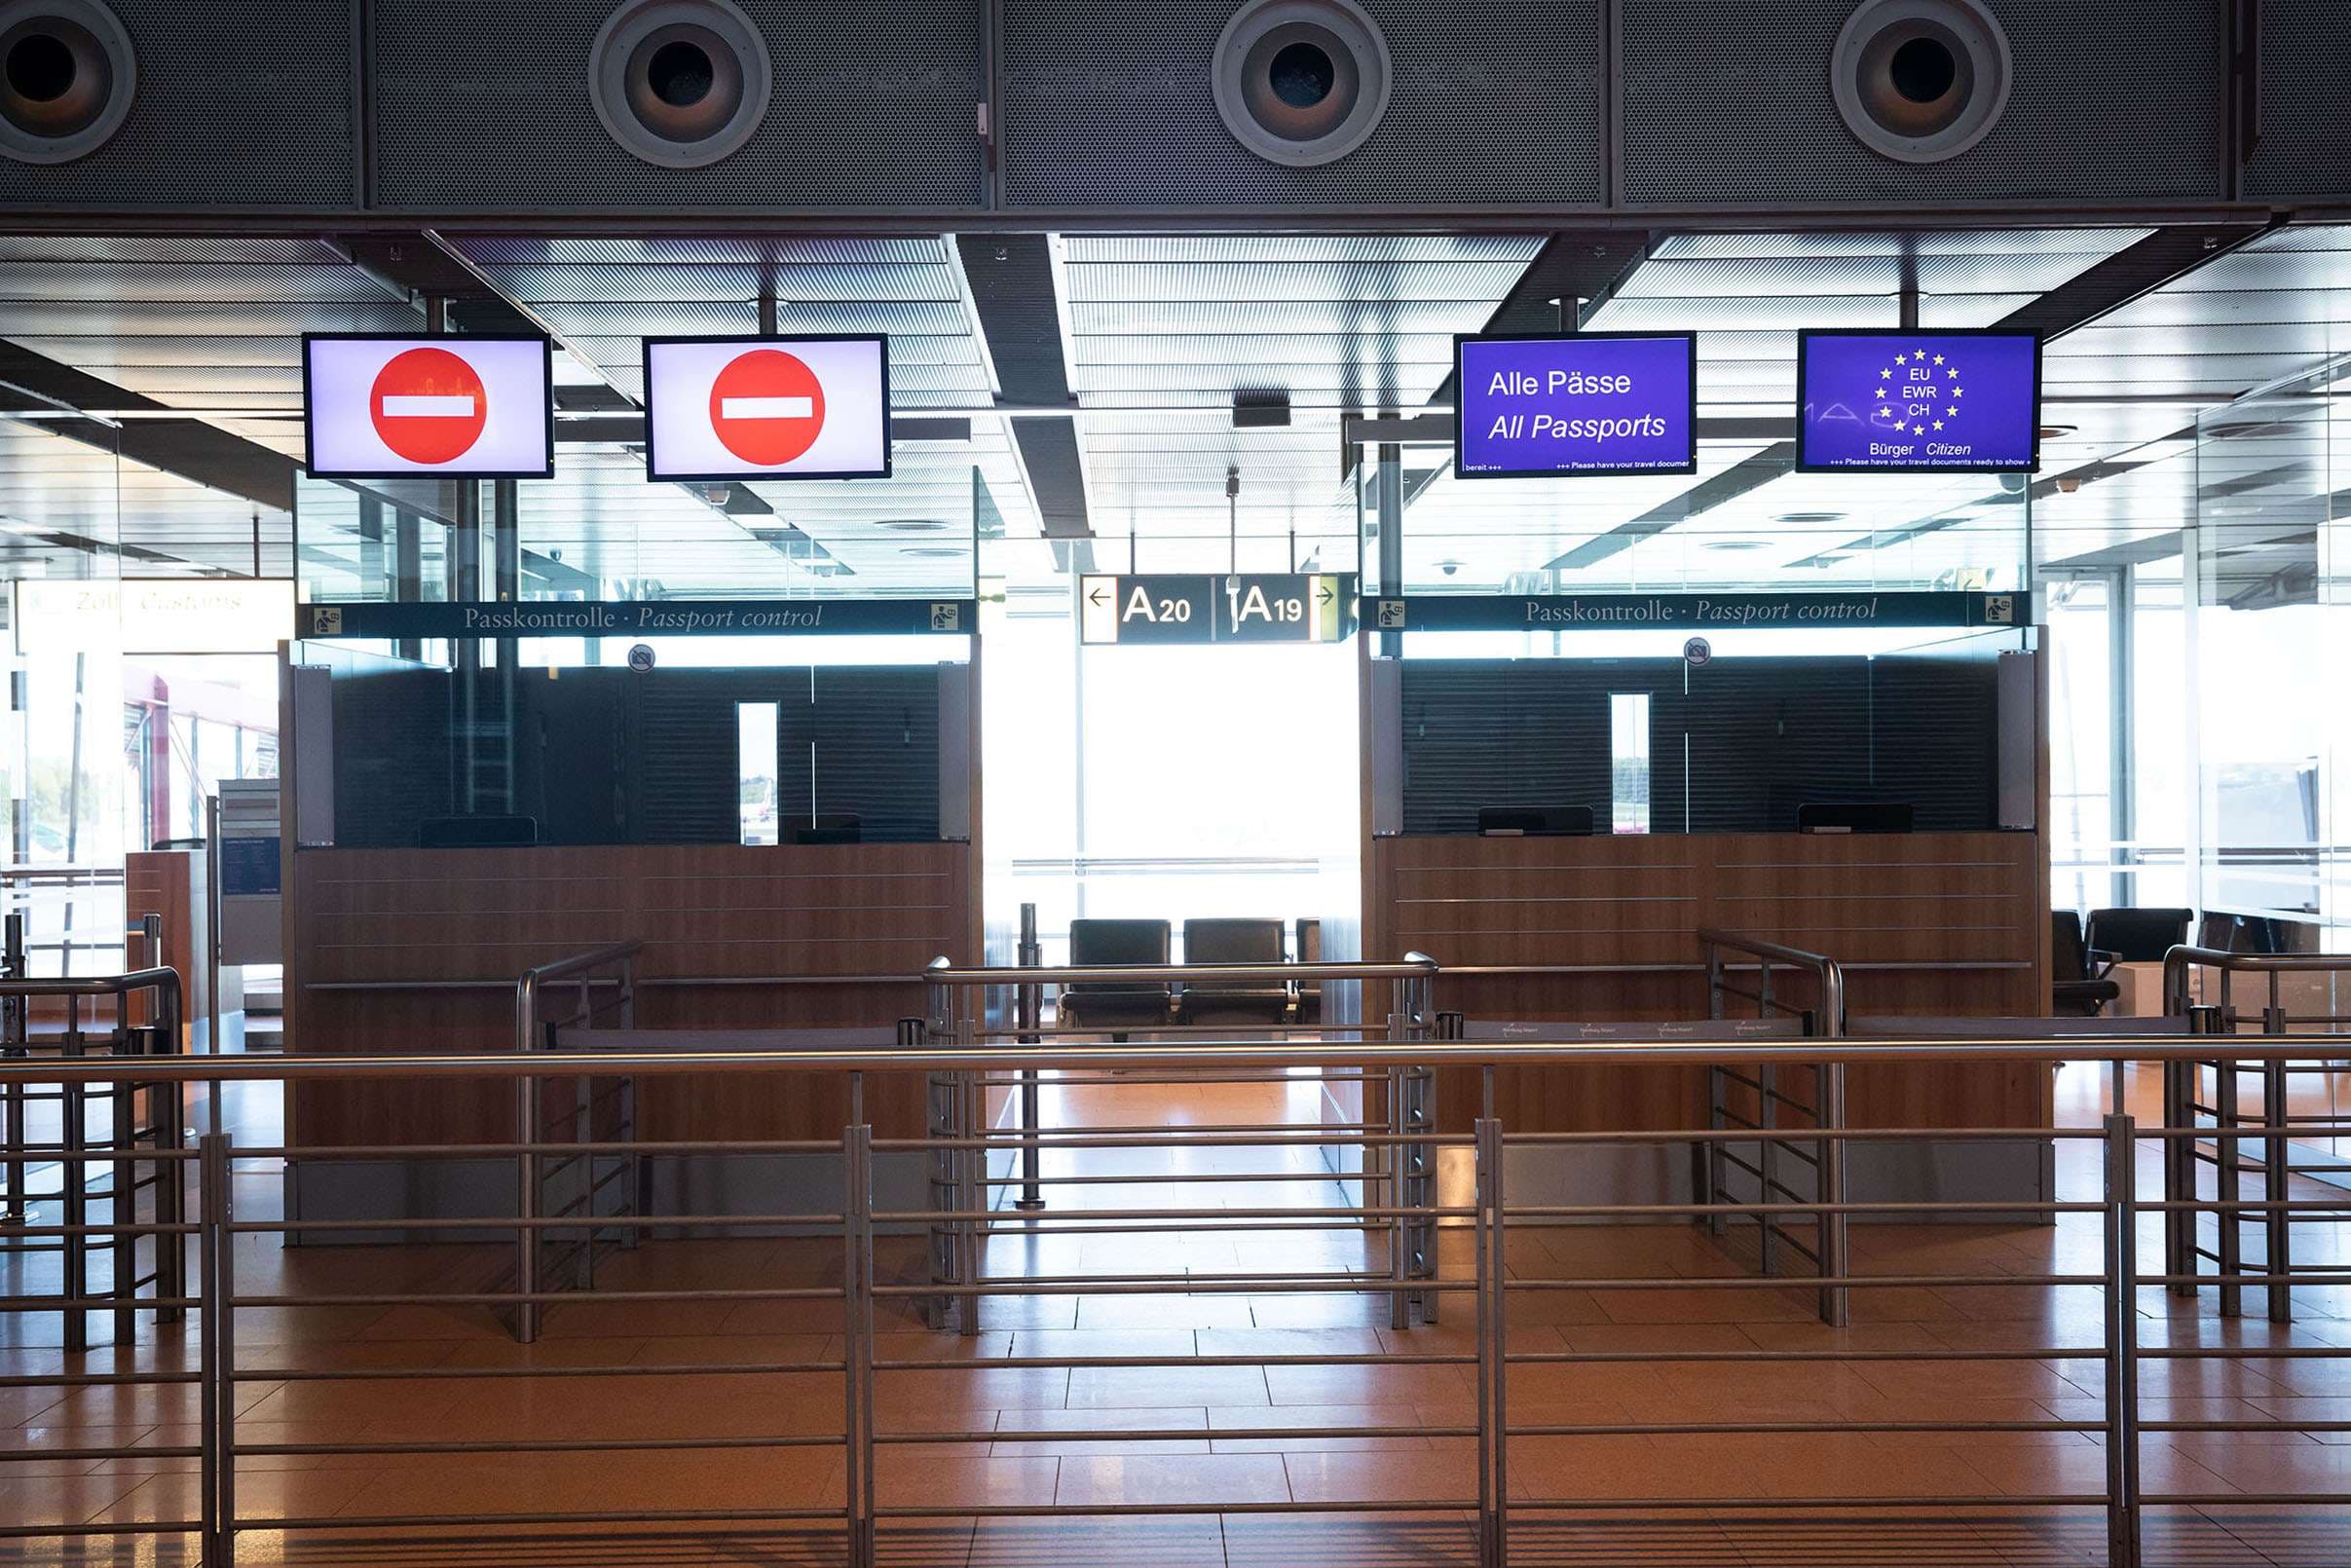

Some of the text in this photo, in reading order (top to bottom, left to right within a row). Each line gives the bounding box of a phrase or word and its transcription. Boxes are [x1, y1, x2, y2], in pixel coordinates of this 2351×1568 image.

[1488, 370, 1631, 395] Alle Pässe
[1910, 368, 1930, 381] EU
[1903, 386, 1937, 398] EWR
[1909, 403, 1930, 416] CH
[1488, 413, 1666, 443] All Passports
[1870, 442, 1971, 458] Bürger Citizen
[1617, 462, 1633, 470] your
[1635, 460, 1656, 468] travel
[465, 606, 823, 632] Passkontrolle Passport control
[1526, 597, 1878, 625] Passkontrolle Passport control
